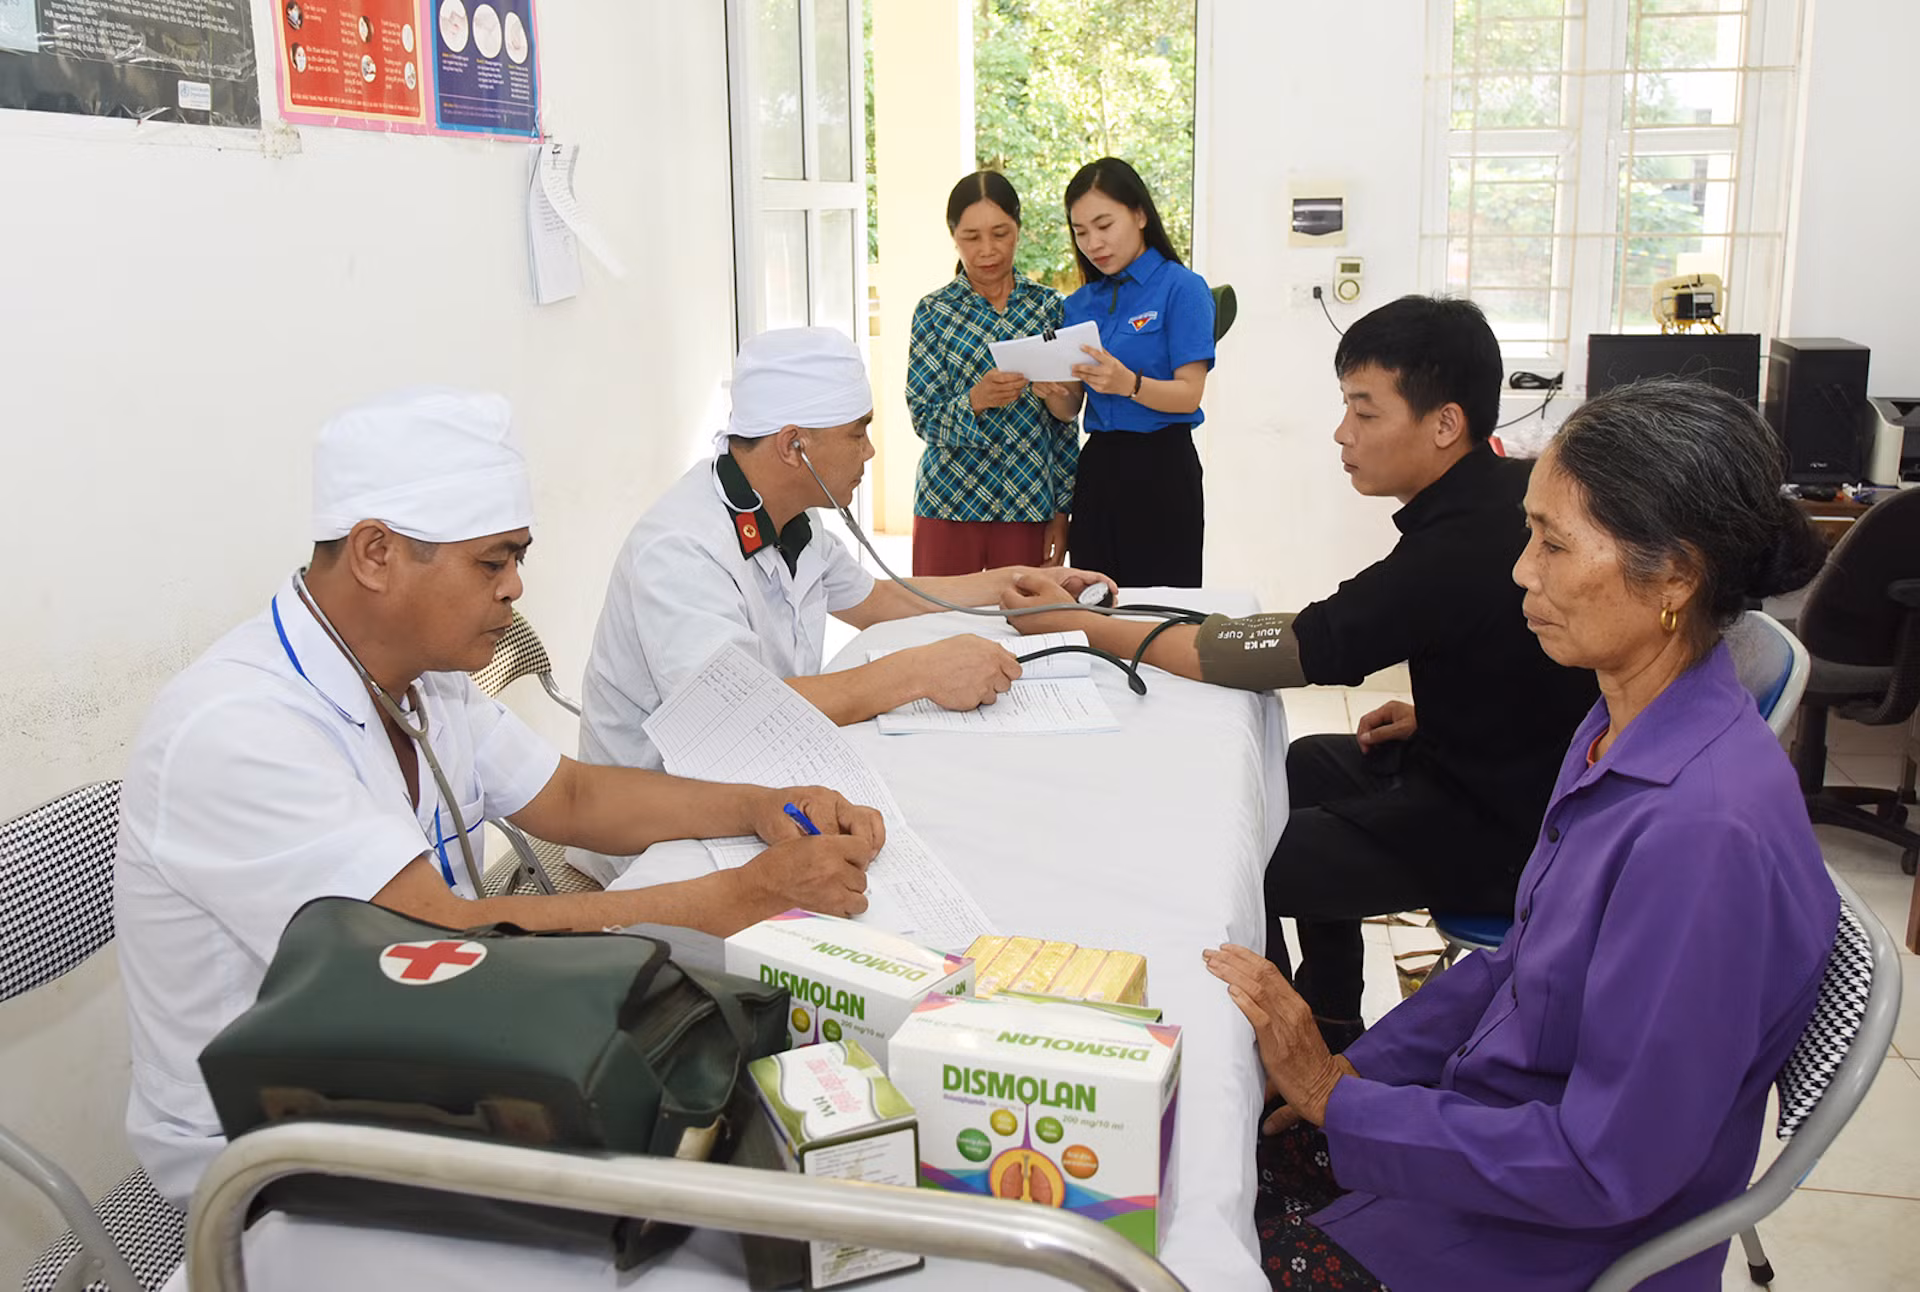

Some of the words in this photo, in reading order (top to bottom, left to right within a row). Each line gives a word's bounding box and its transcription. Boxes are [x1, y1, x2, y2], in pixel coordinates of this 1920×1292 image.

[1217, 630, 1244, 639] CUFF
[1248, 627, 1282, 639] ADULT
[812, 942, 928, 982] DISMOLAN
[760, 963, 865, 1020] DISMOLAN
[996, 1031, 1151, 1062] DISMOLAN
[943, 1063, 1096, 1113] DISMOLAN
[1062, 1114, 1079, 1125] 200
[1080, 1119, 1110, 1129] mg/10
[1111, 1121, 1124, 1131] ml
